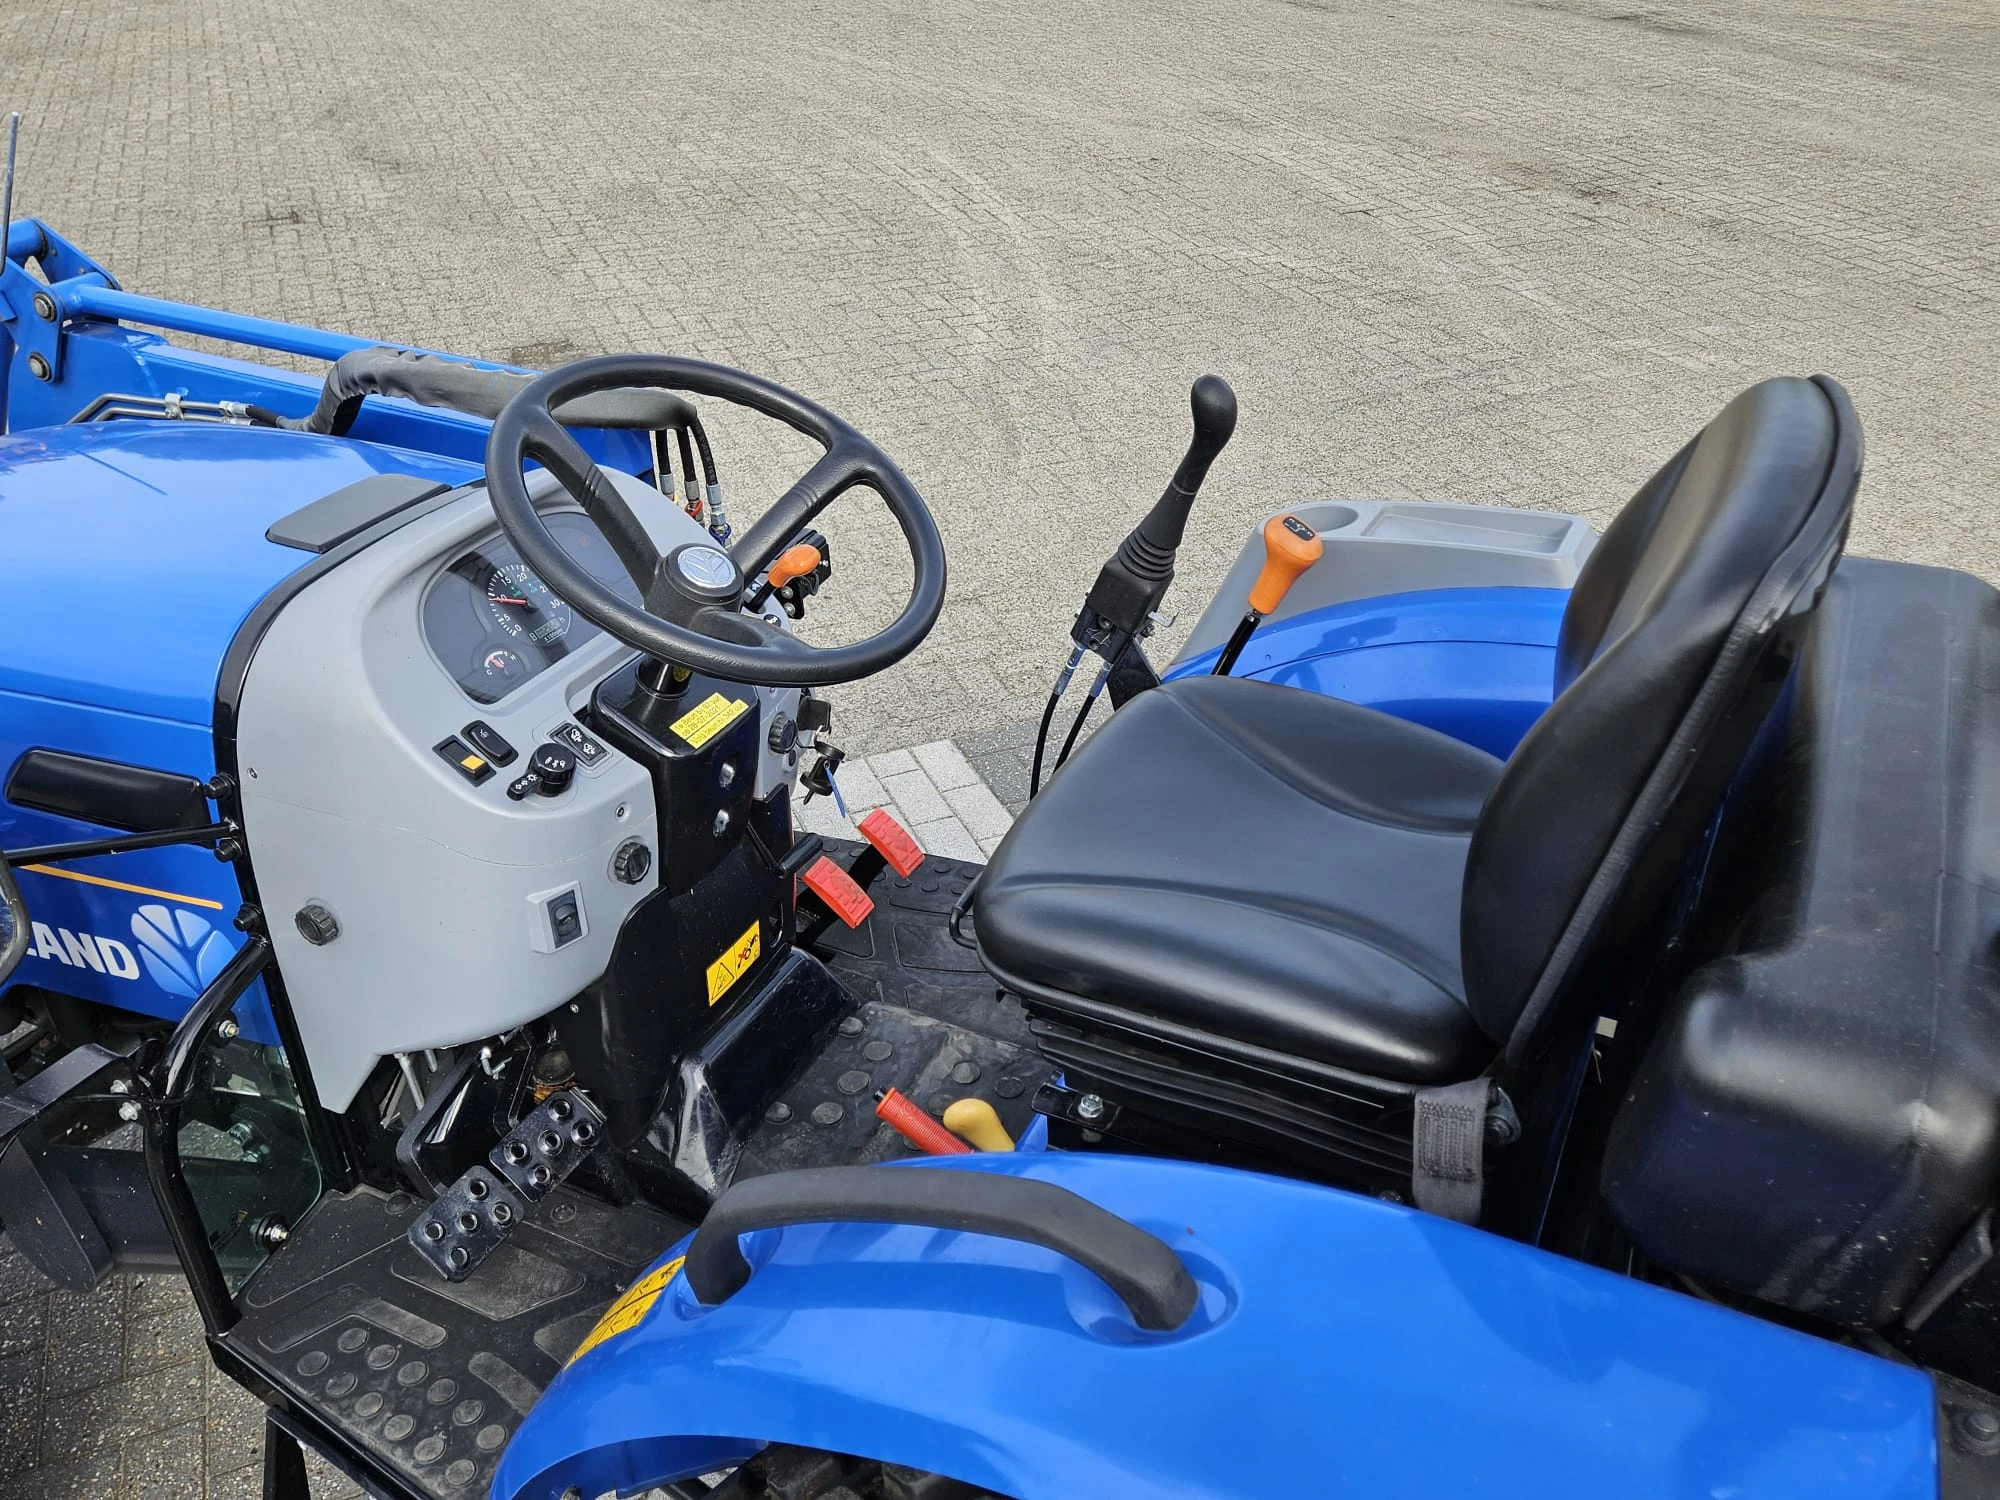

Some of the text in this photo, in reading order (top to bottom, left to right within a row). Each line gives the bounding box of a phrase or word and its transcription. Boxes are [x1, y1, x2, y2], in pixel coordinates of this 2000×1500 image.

[501, 576, 511, 586] 15
[517, 572, 527, 582] 20
[550, 598, 560, 608] 30
[514, 624, 522, 632] 0
[26, 921, 141, 980] AND
